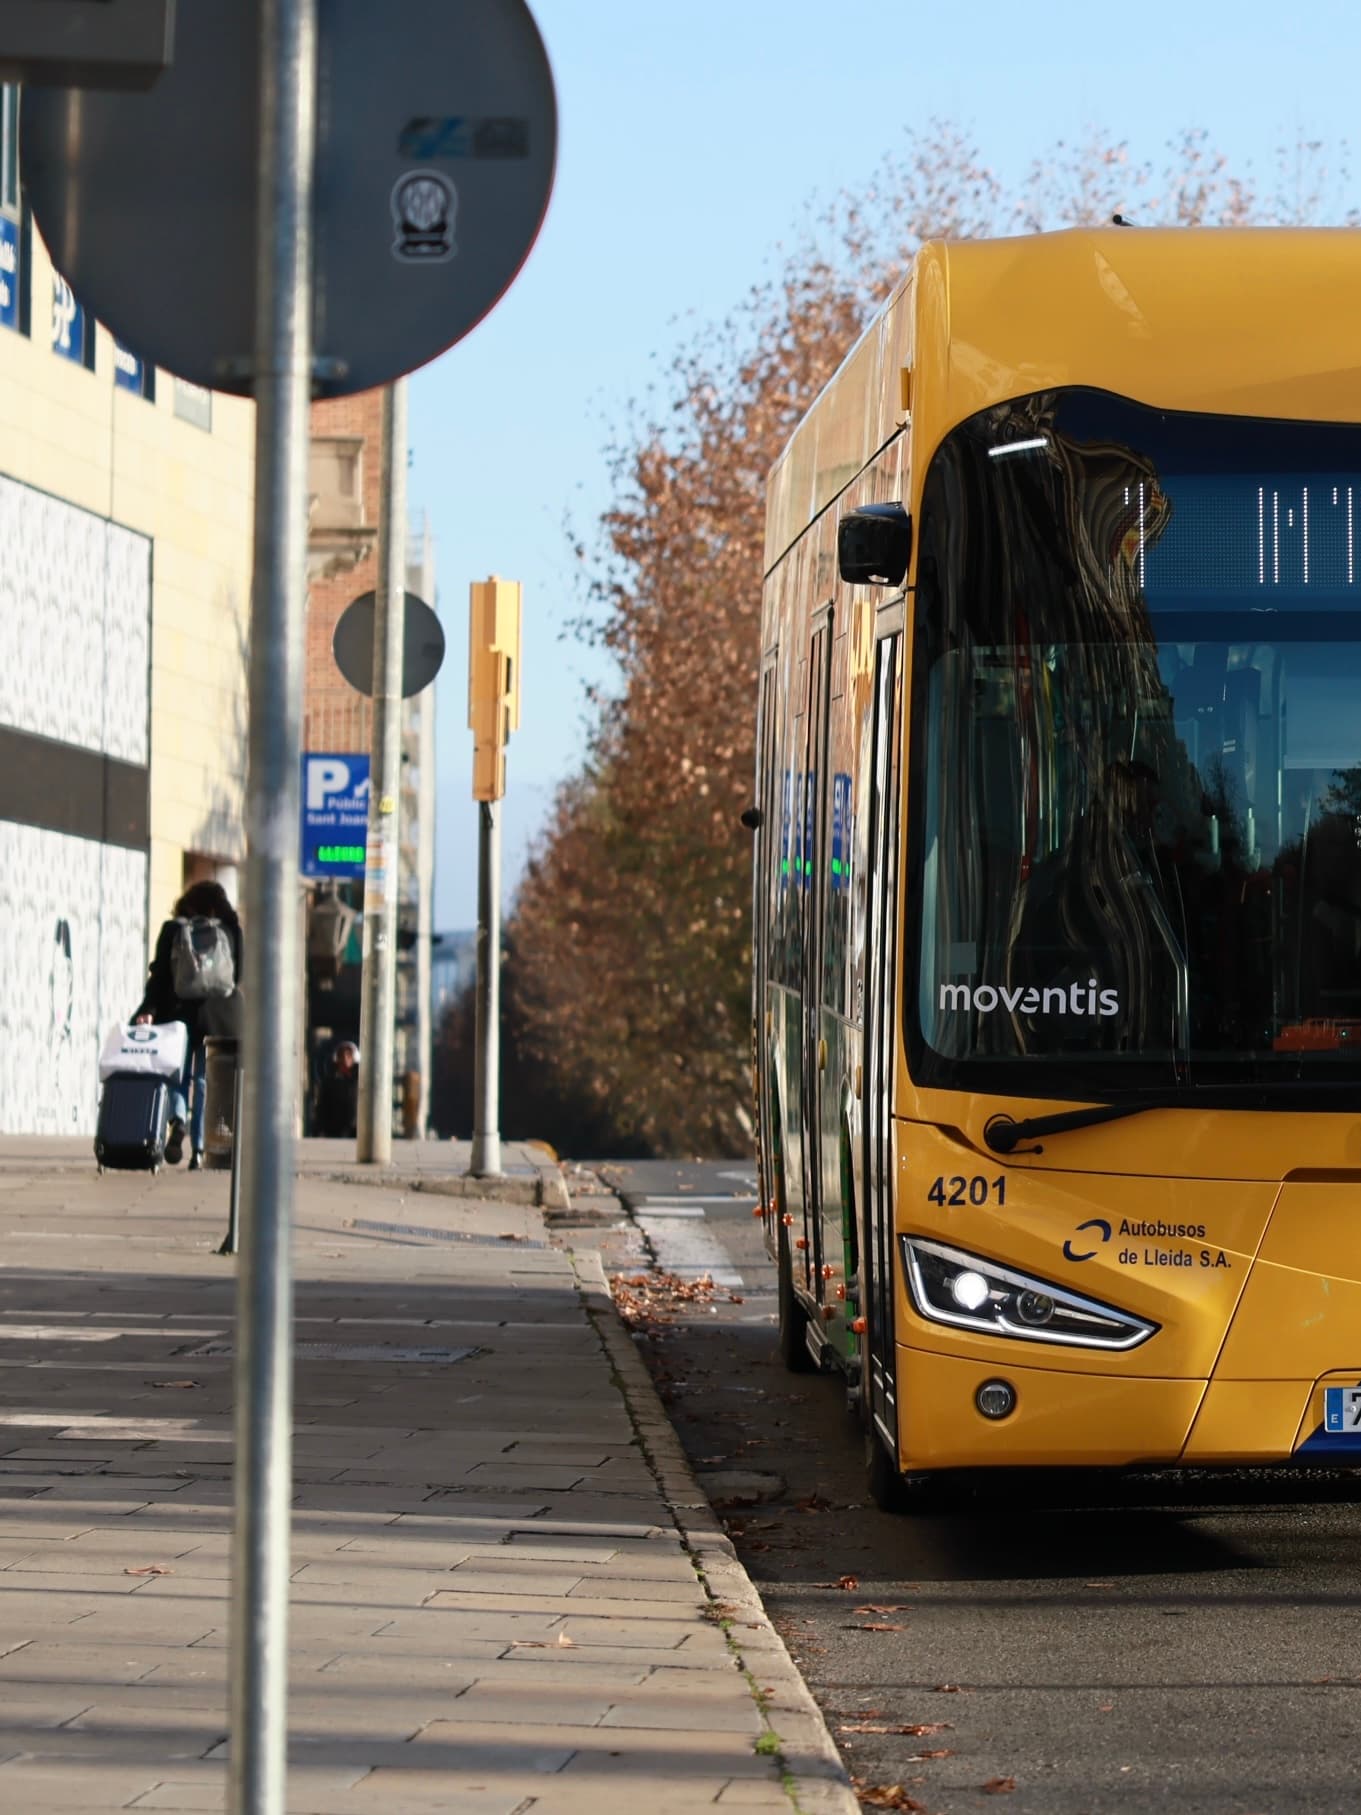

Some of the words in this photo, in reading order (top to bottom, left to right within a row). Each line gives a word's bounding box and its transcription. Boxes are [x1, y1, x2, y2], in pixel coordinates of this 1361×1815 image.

[306, 758, 351, 811] P
[939, 978, 1119, 1016] moventis
[927, 1175, 1006, 1207] 4201
[1118, 1218, 1206, 1239] Autobusos
[1118, 1248, 1138, 1265] de
[1143, 1249, 1193, 1267] Lleida
[1200, 1251, 1232, 1268] S.A.
[1331, 1413, 1339, 1424] E
